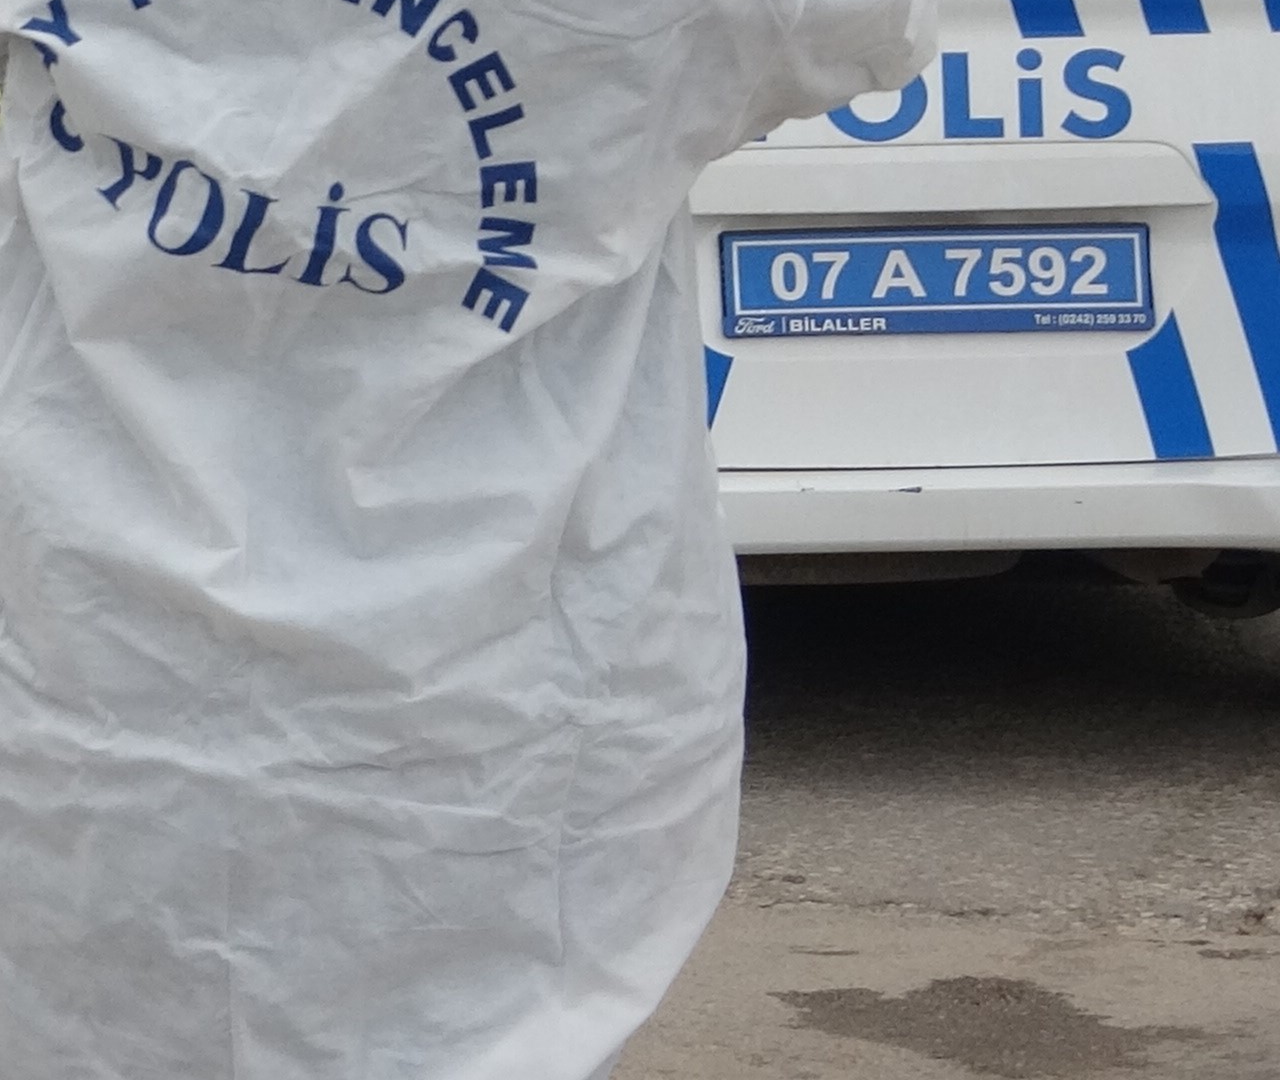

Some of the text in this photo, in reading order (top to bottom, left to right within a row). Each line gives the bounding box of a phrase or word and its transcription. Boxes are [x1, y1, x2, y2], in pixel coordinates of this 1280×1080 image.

[754, 48, 1132, 142] OLİS
[770, 246, 1109, 301] 07 A 7592
[734, 317, 775, 334] Ford
